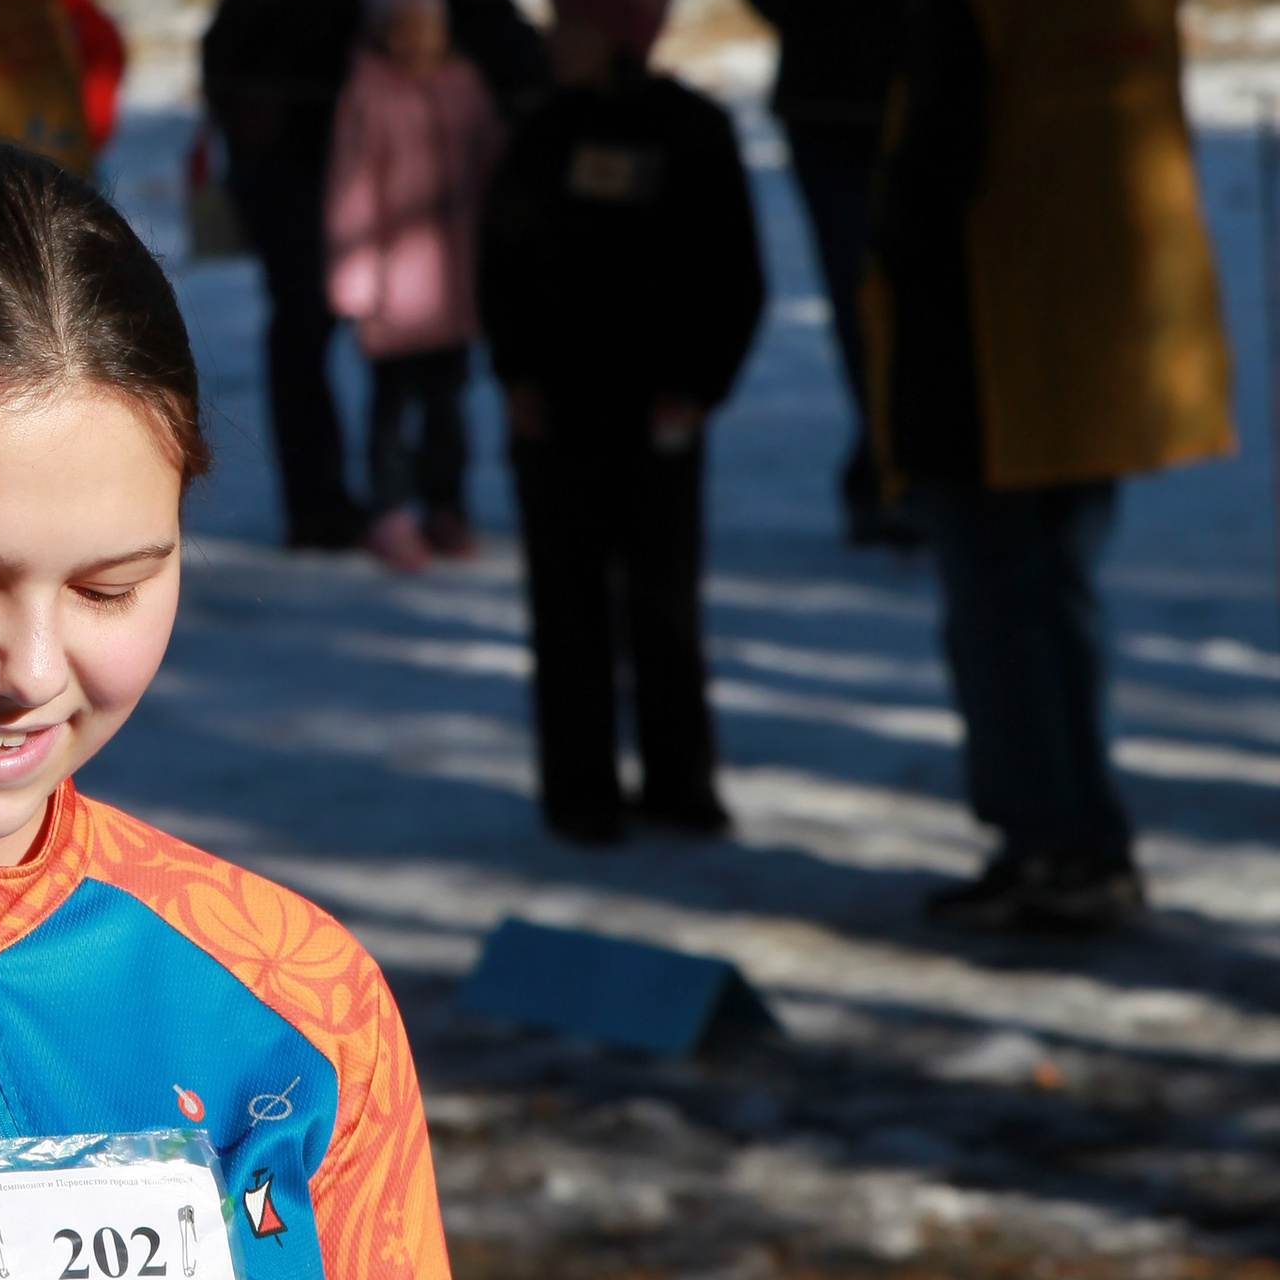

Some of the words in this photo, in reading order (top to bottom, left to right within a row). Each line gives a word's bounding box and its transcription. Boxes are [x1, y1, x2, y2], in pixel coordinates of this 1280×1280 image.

[56, 1178, 108, 1188] Первенство
[110, 1178, 139, 1188] города
[53, 1226, 167, 1280] 202
